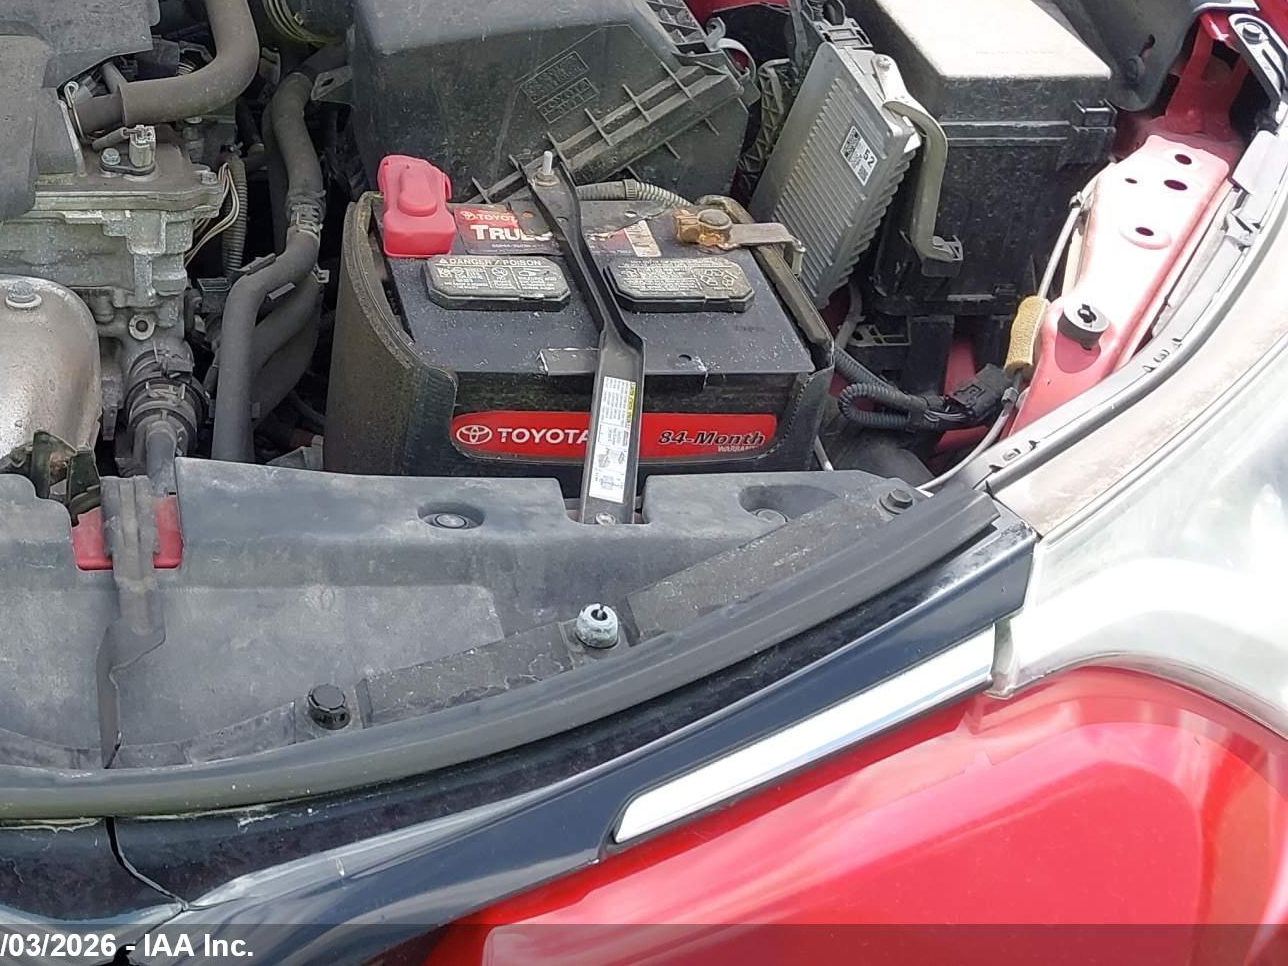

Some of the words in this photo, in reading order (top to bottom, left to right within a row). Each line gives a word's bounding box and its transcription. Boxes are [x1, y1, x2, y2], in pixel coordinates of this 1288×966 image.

[864, 149, 875, 168] 52
[475, 214, 519, 223] TOYOT
[449, 258, 491, 266] DANGER
[497, 428, 589, 444] TOYOTA
[658, 430, 766, 445] 84-Month
